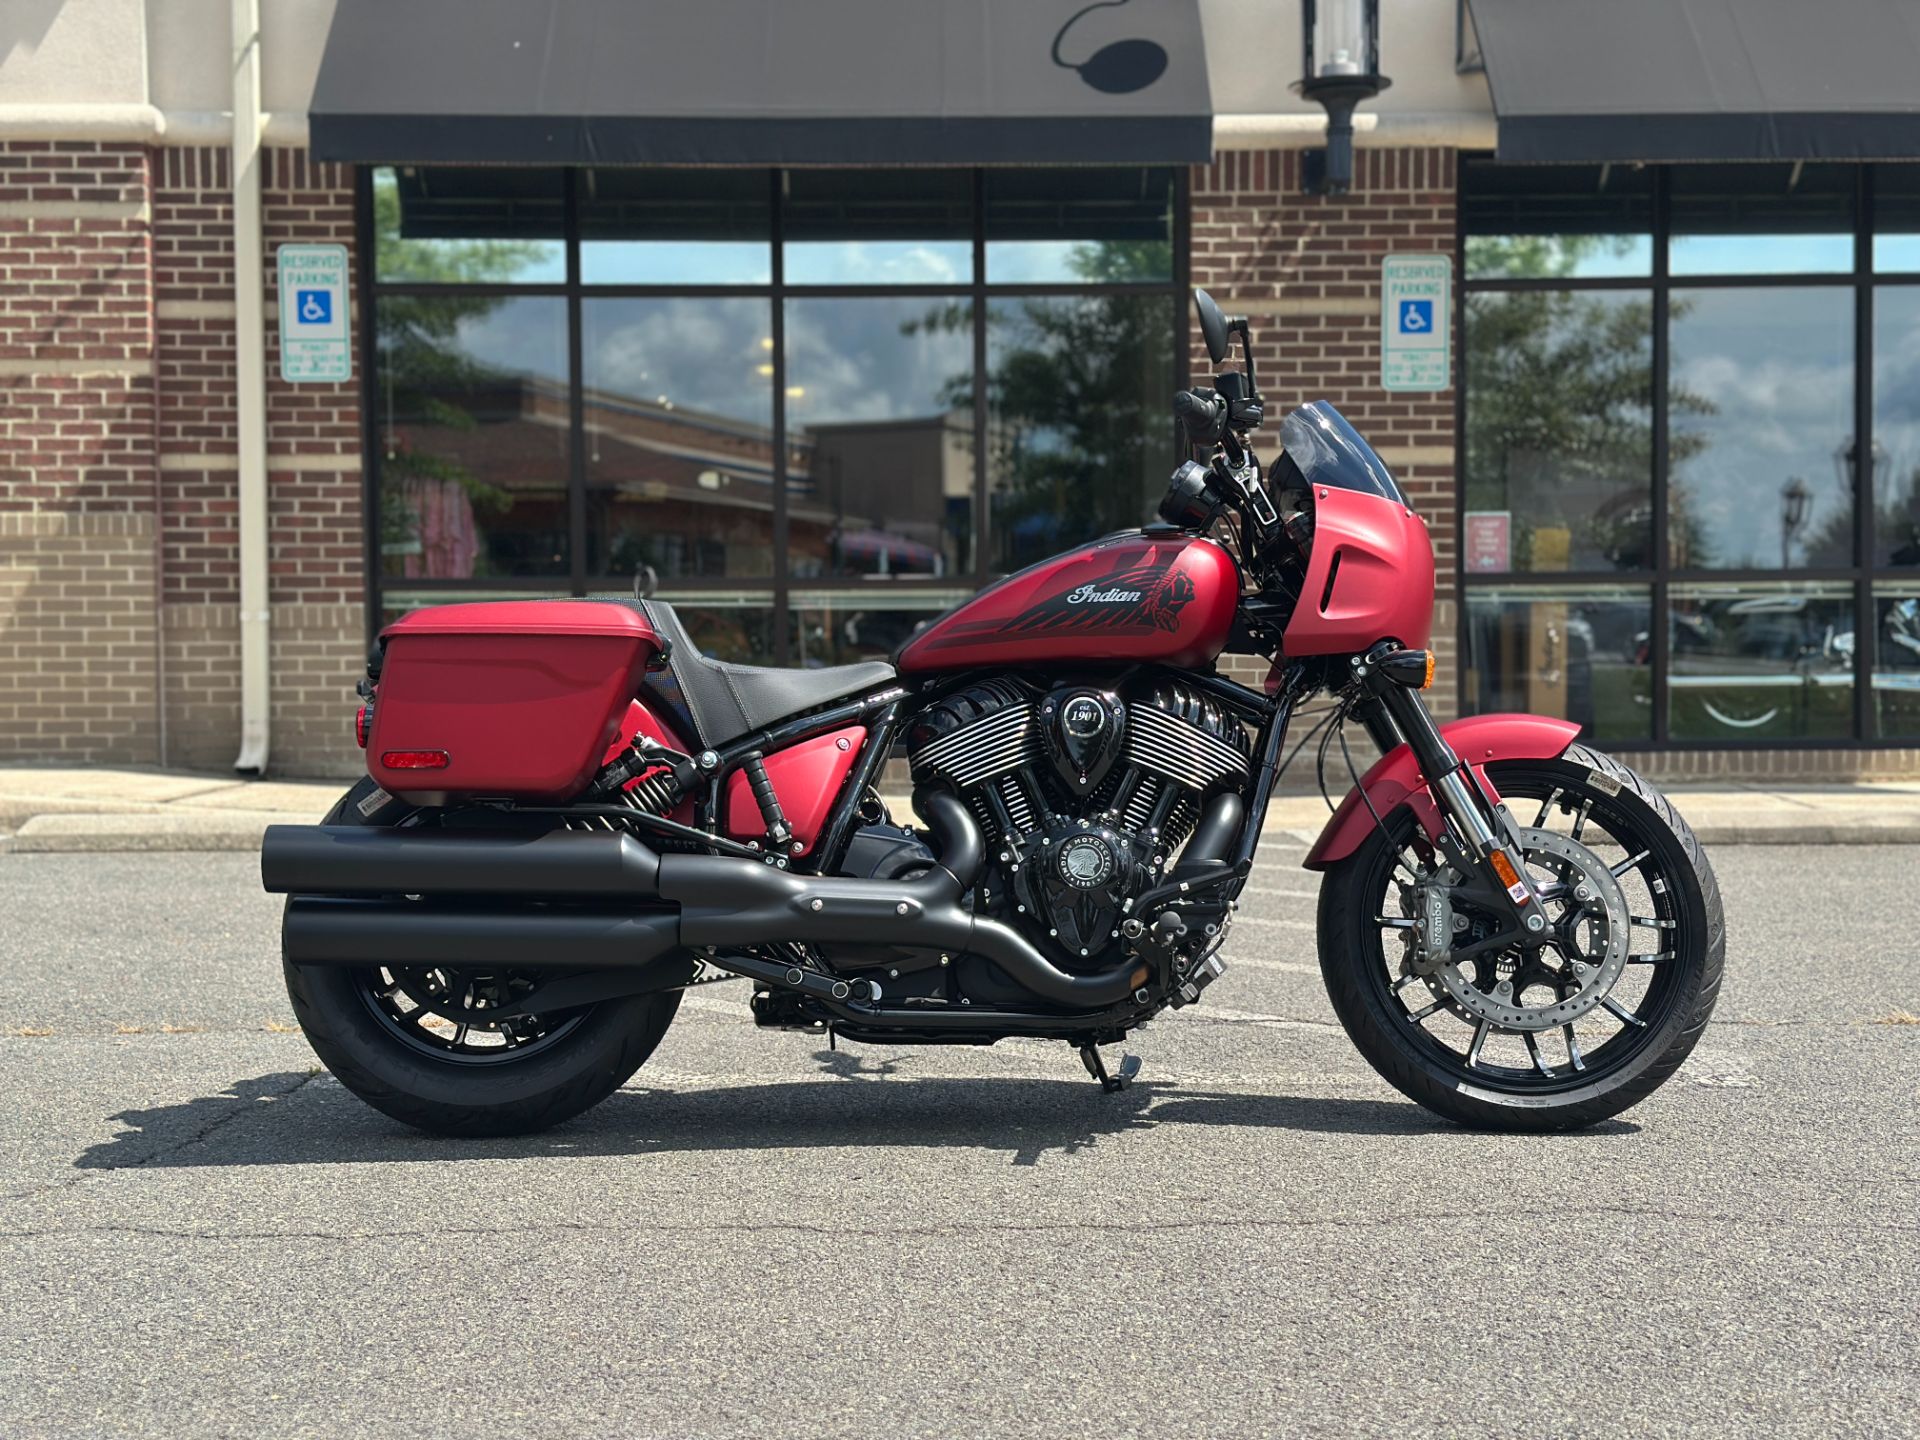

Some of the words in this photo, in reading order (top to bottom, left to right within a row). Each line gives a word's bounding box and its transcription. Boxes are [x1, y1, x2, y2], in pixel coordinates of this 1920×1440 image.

[287, 273, 338, 285] PARKING
[1391, 283, 1441, 295] PARKING
[1066, 584, 1141, 604] Indian
[1071, 711, 1097, 721] 1901
[1060, 844, 1072, 877] INDIAN
[1074, 837, 1110, 878] MOTORCYCLE
[1432, 901, 1442, 946] brembo
